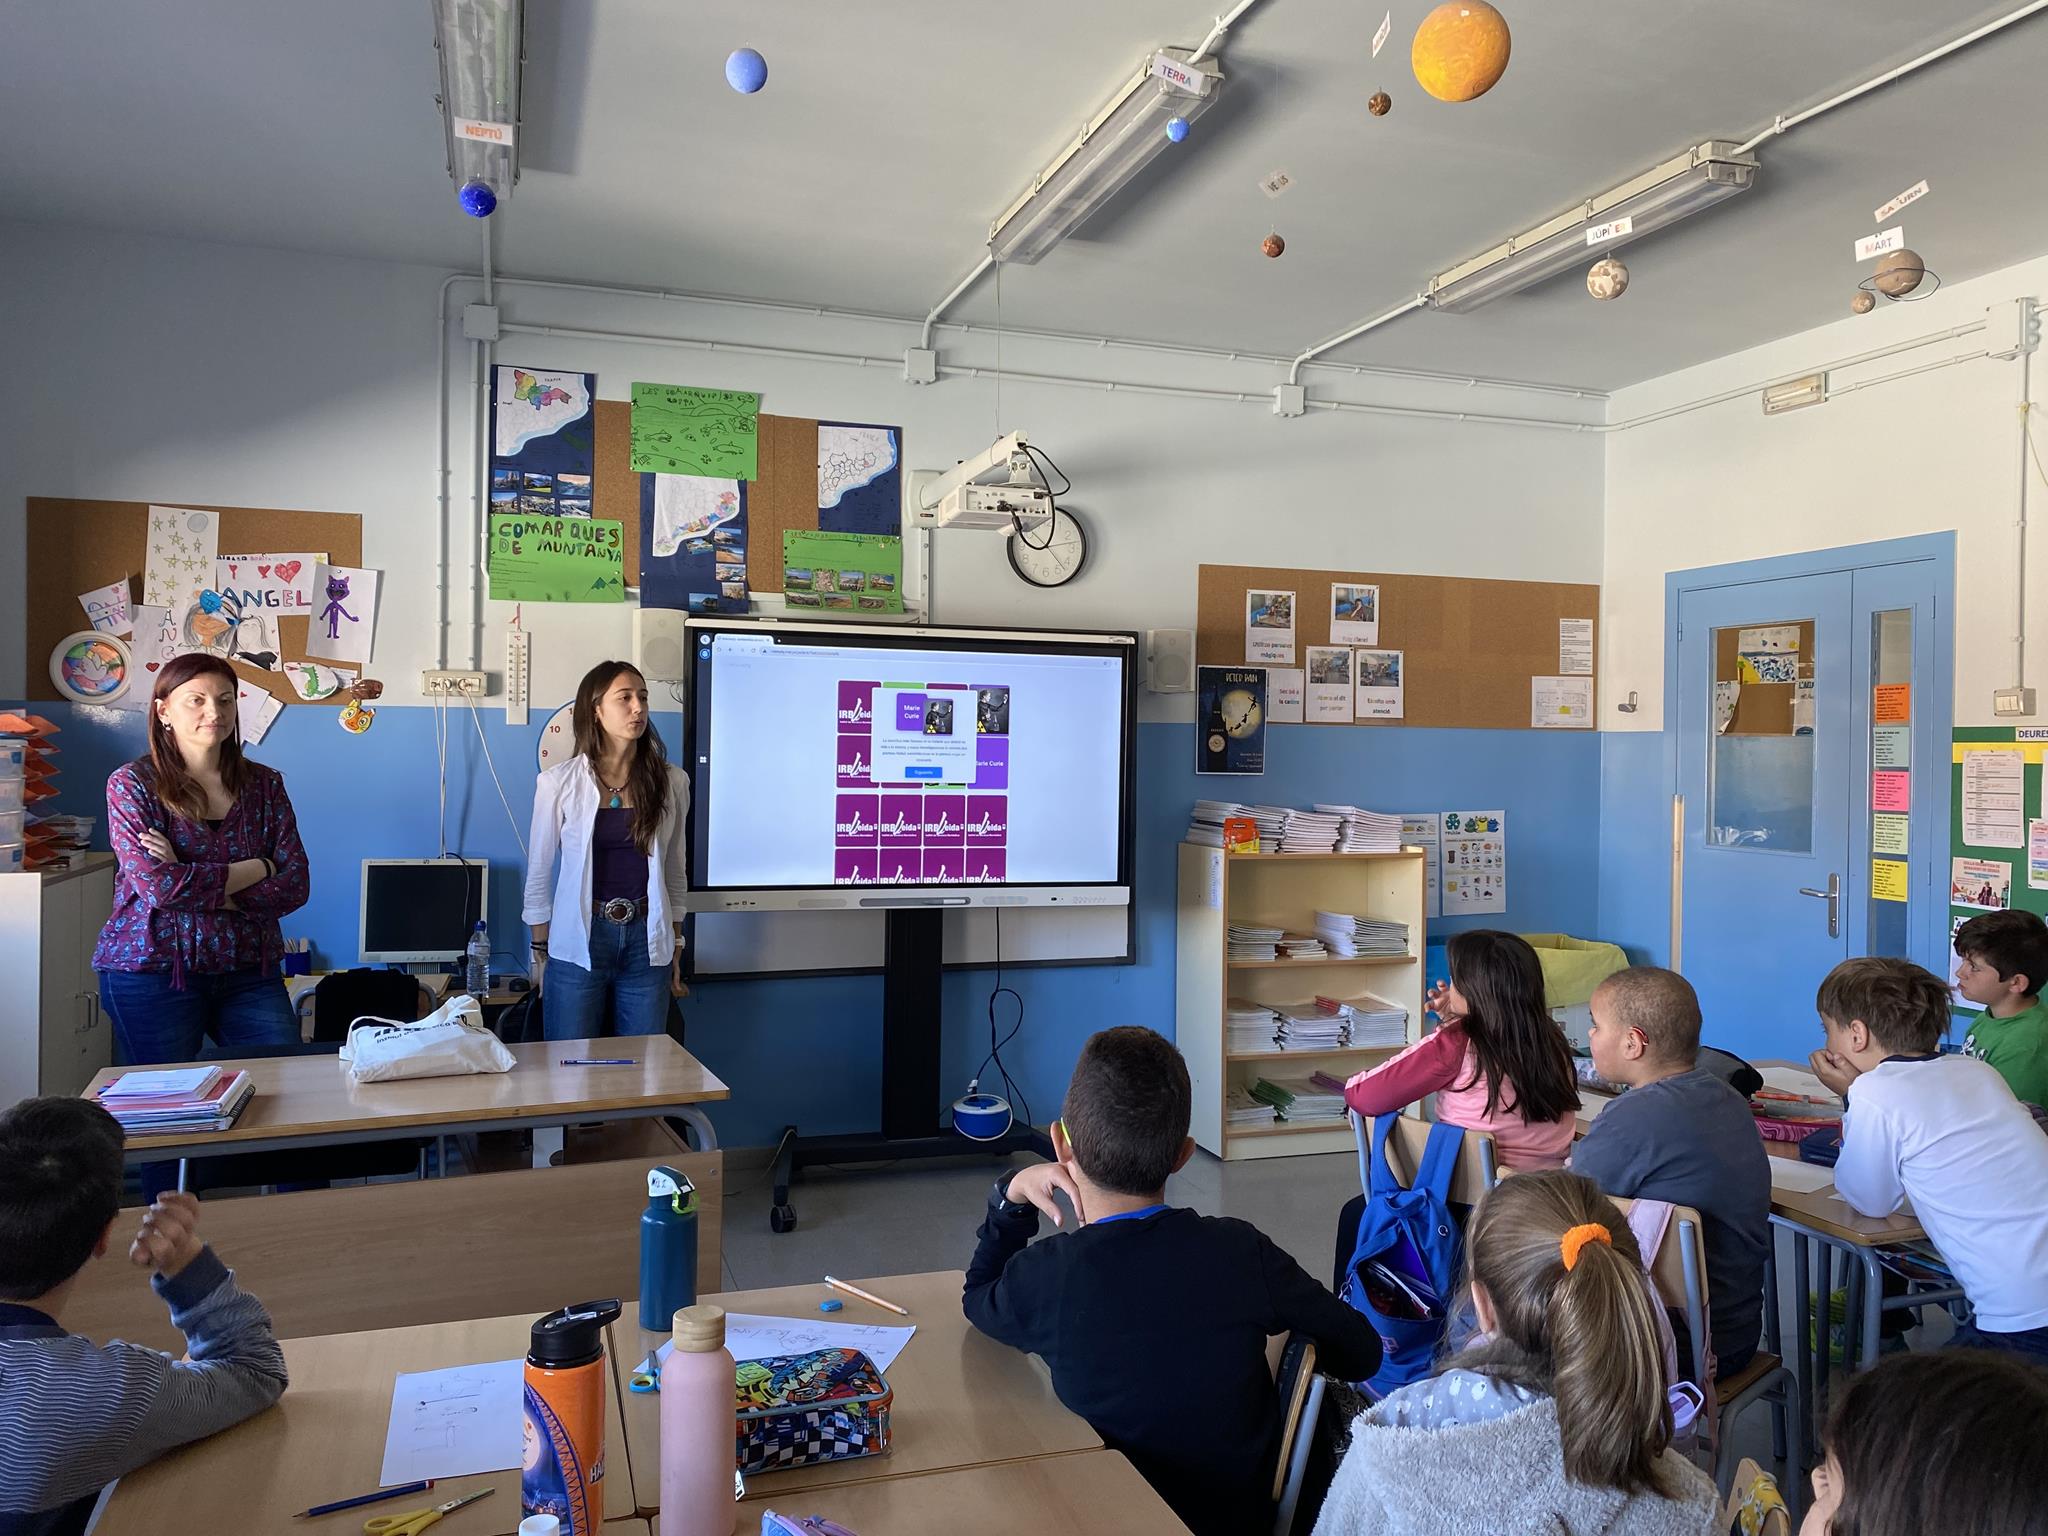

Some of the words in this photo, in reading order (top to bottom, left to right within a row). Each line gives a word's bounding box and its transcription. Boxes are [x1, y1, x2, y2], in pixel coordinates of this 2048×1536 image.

[1162, 64, 1191, 87] TERRA
[1881, 187, 1922, 217] SAURN
[498, 538, 522, 555] DE
[537, 540, 622, 563] MUNTANYA
[223, 587, 312, 608] ANGEL
